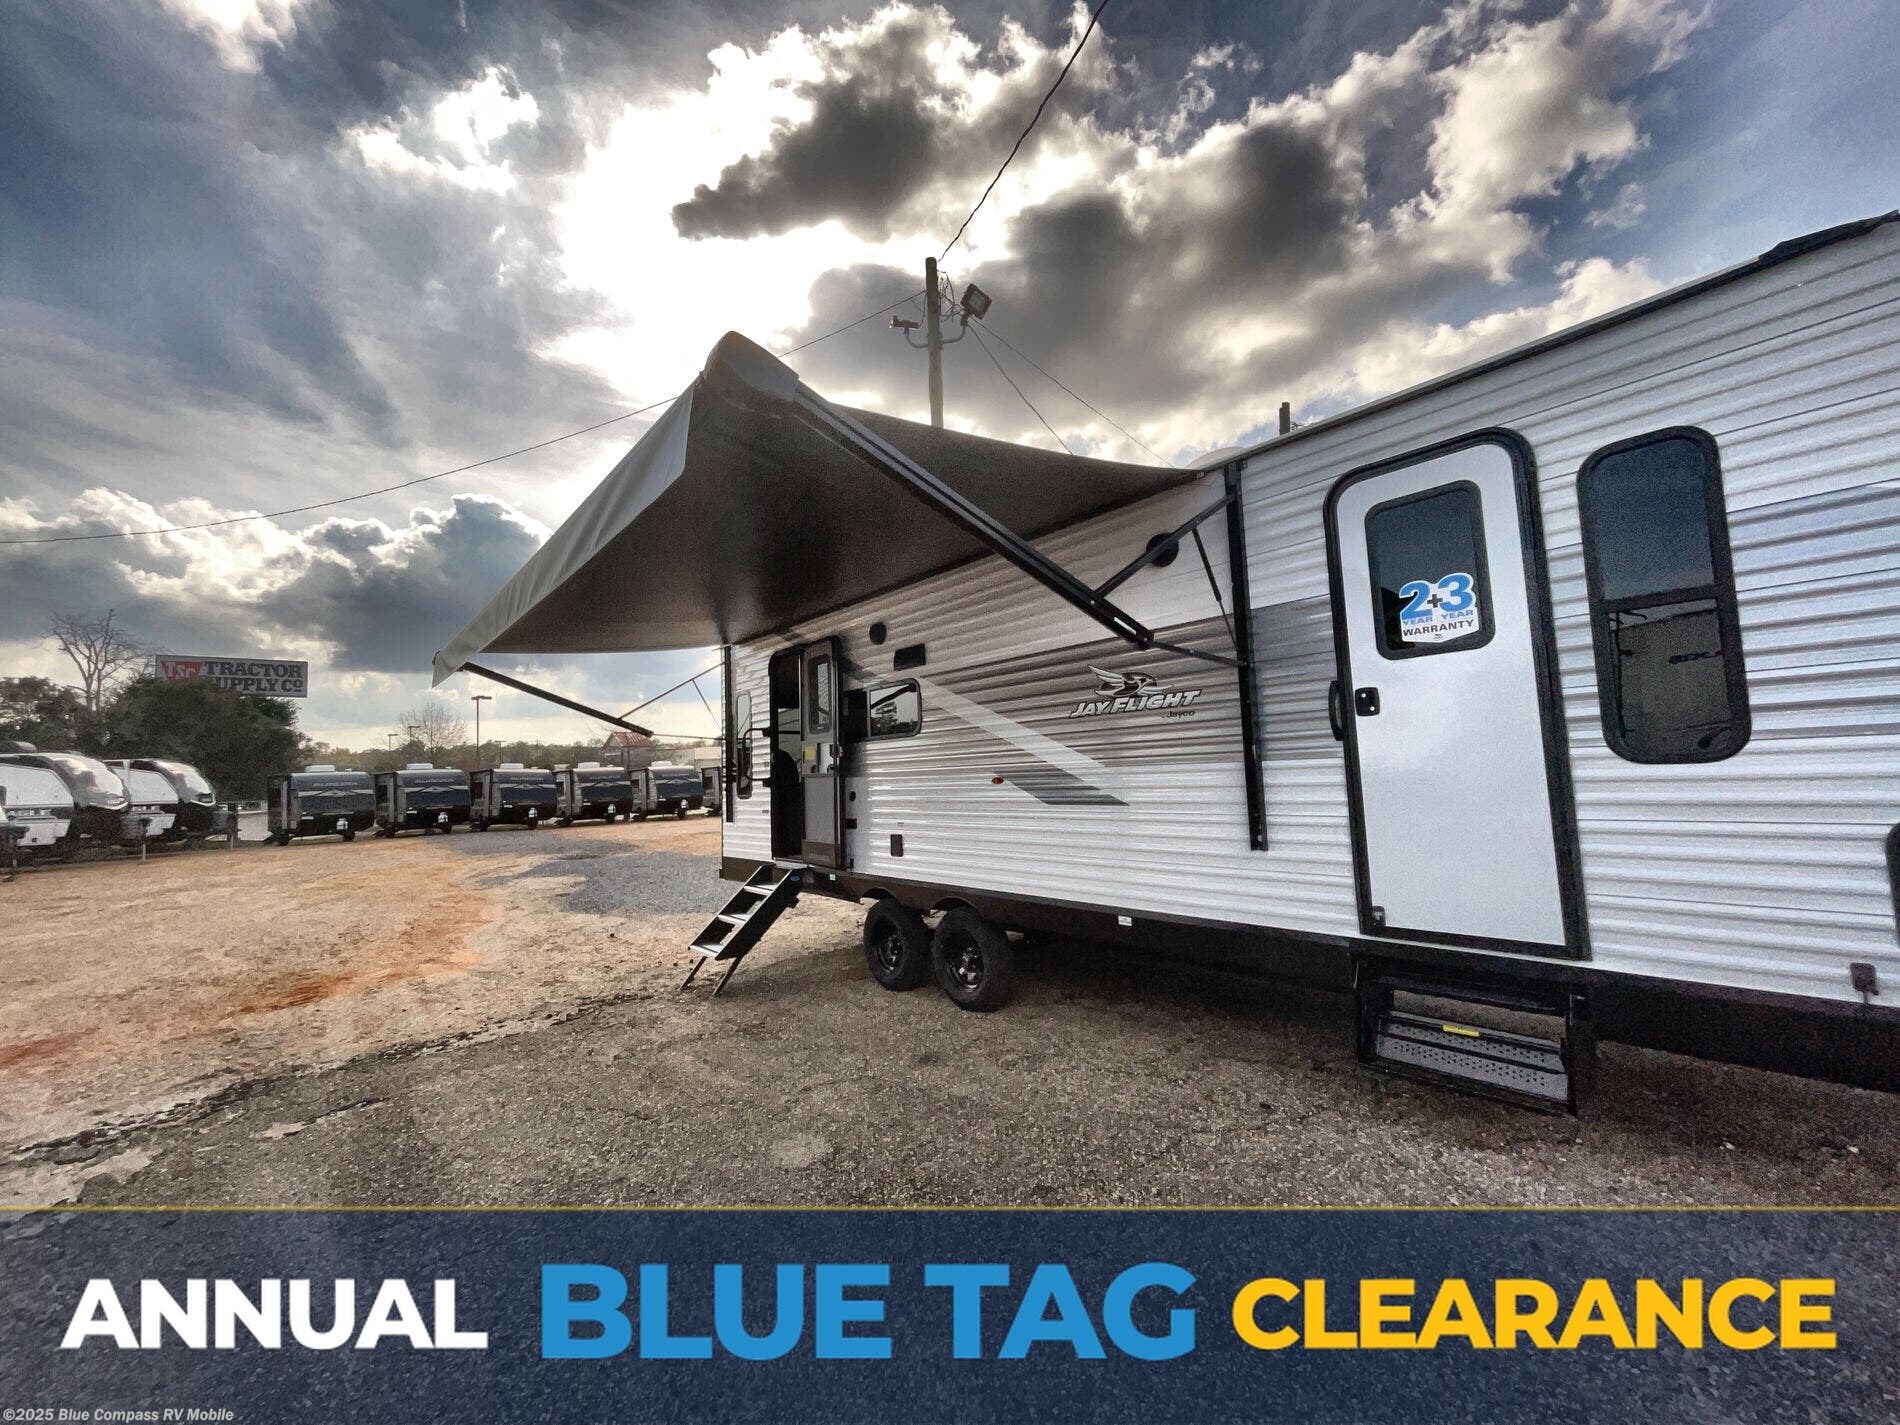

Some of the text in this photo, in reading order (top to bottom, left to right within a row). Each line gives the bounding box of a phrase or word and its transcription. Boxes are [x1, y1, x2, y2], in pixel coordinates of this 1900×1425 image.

[1402, 609, 1474, 626] YEAR YEAR
[1403, 619, 1474, 636] WARRANTY
[205, 661, 303, 678] TRACTOR
[208, 676, 278, 692] UPPLY
[1069, 689, 1202, 719] JAY FLIGHT
